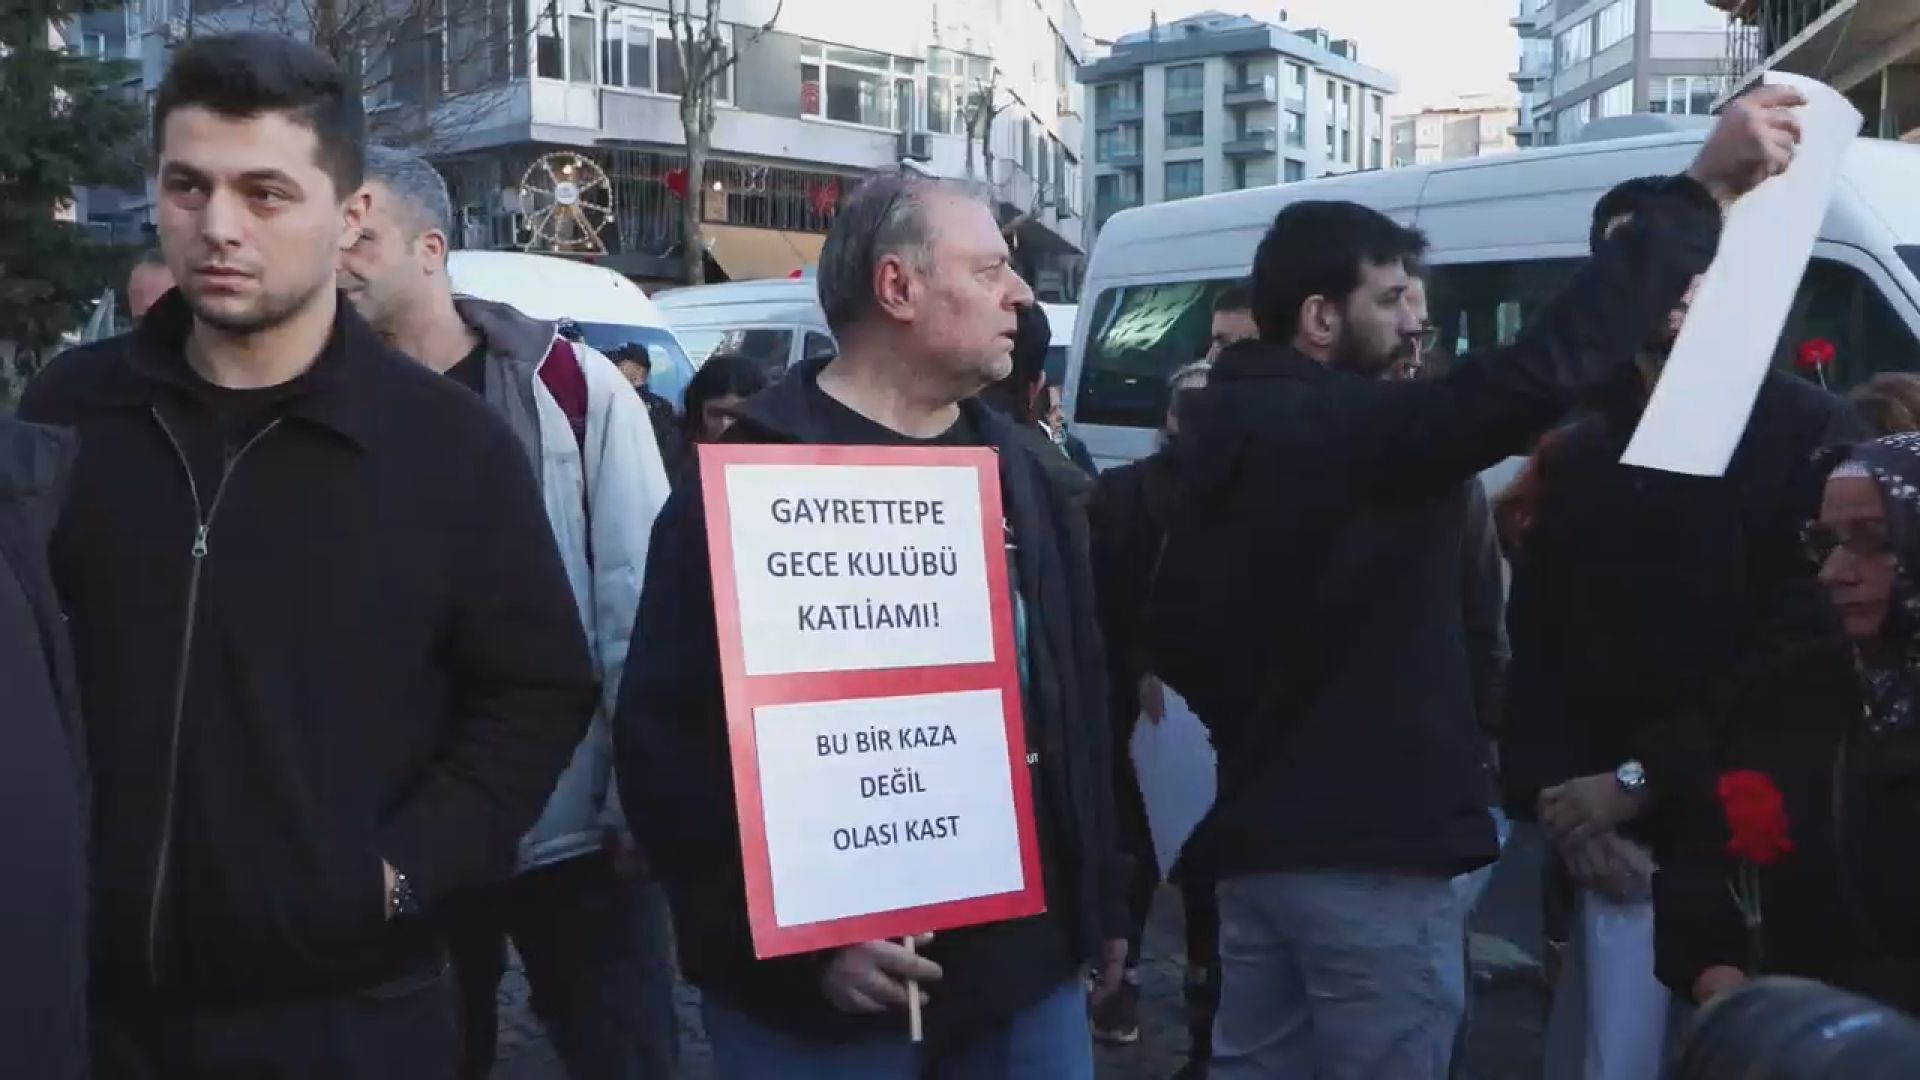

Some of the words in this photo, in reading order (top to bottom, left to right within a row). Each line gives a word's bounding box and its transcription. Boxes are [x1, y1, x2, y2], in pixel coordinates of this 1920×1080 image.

[771, 498, 945, 525] GAYRETTEPE
[767, 551, 839, 578] GECE
[848, 546, 958, 577] KULÜBÜ
[798, 597, 940, 631] KATLİAMI!
[816, 732, 848, 757] BU
[856, 725, 893, 753] BİR
[899, 724, 957, 750] KAZA
[860, 767, 927, 799] DEĞİL
[833, 822, 898, 851] OLASI
[905, 815, 960, 842] KAST
